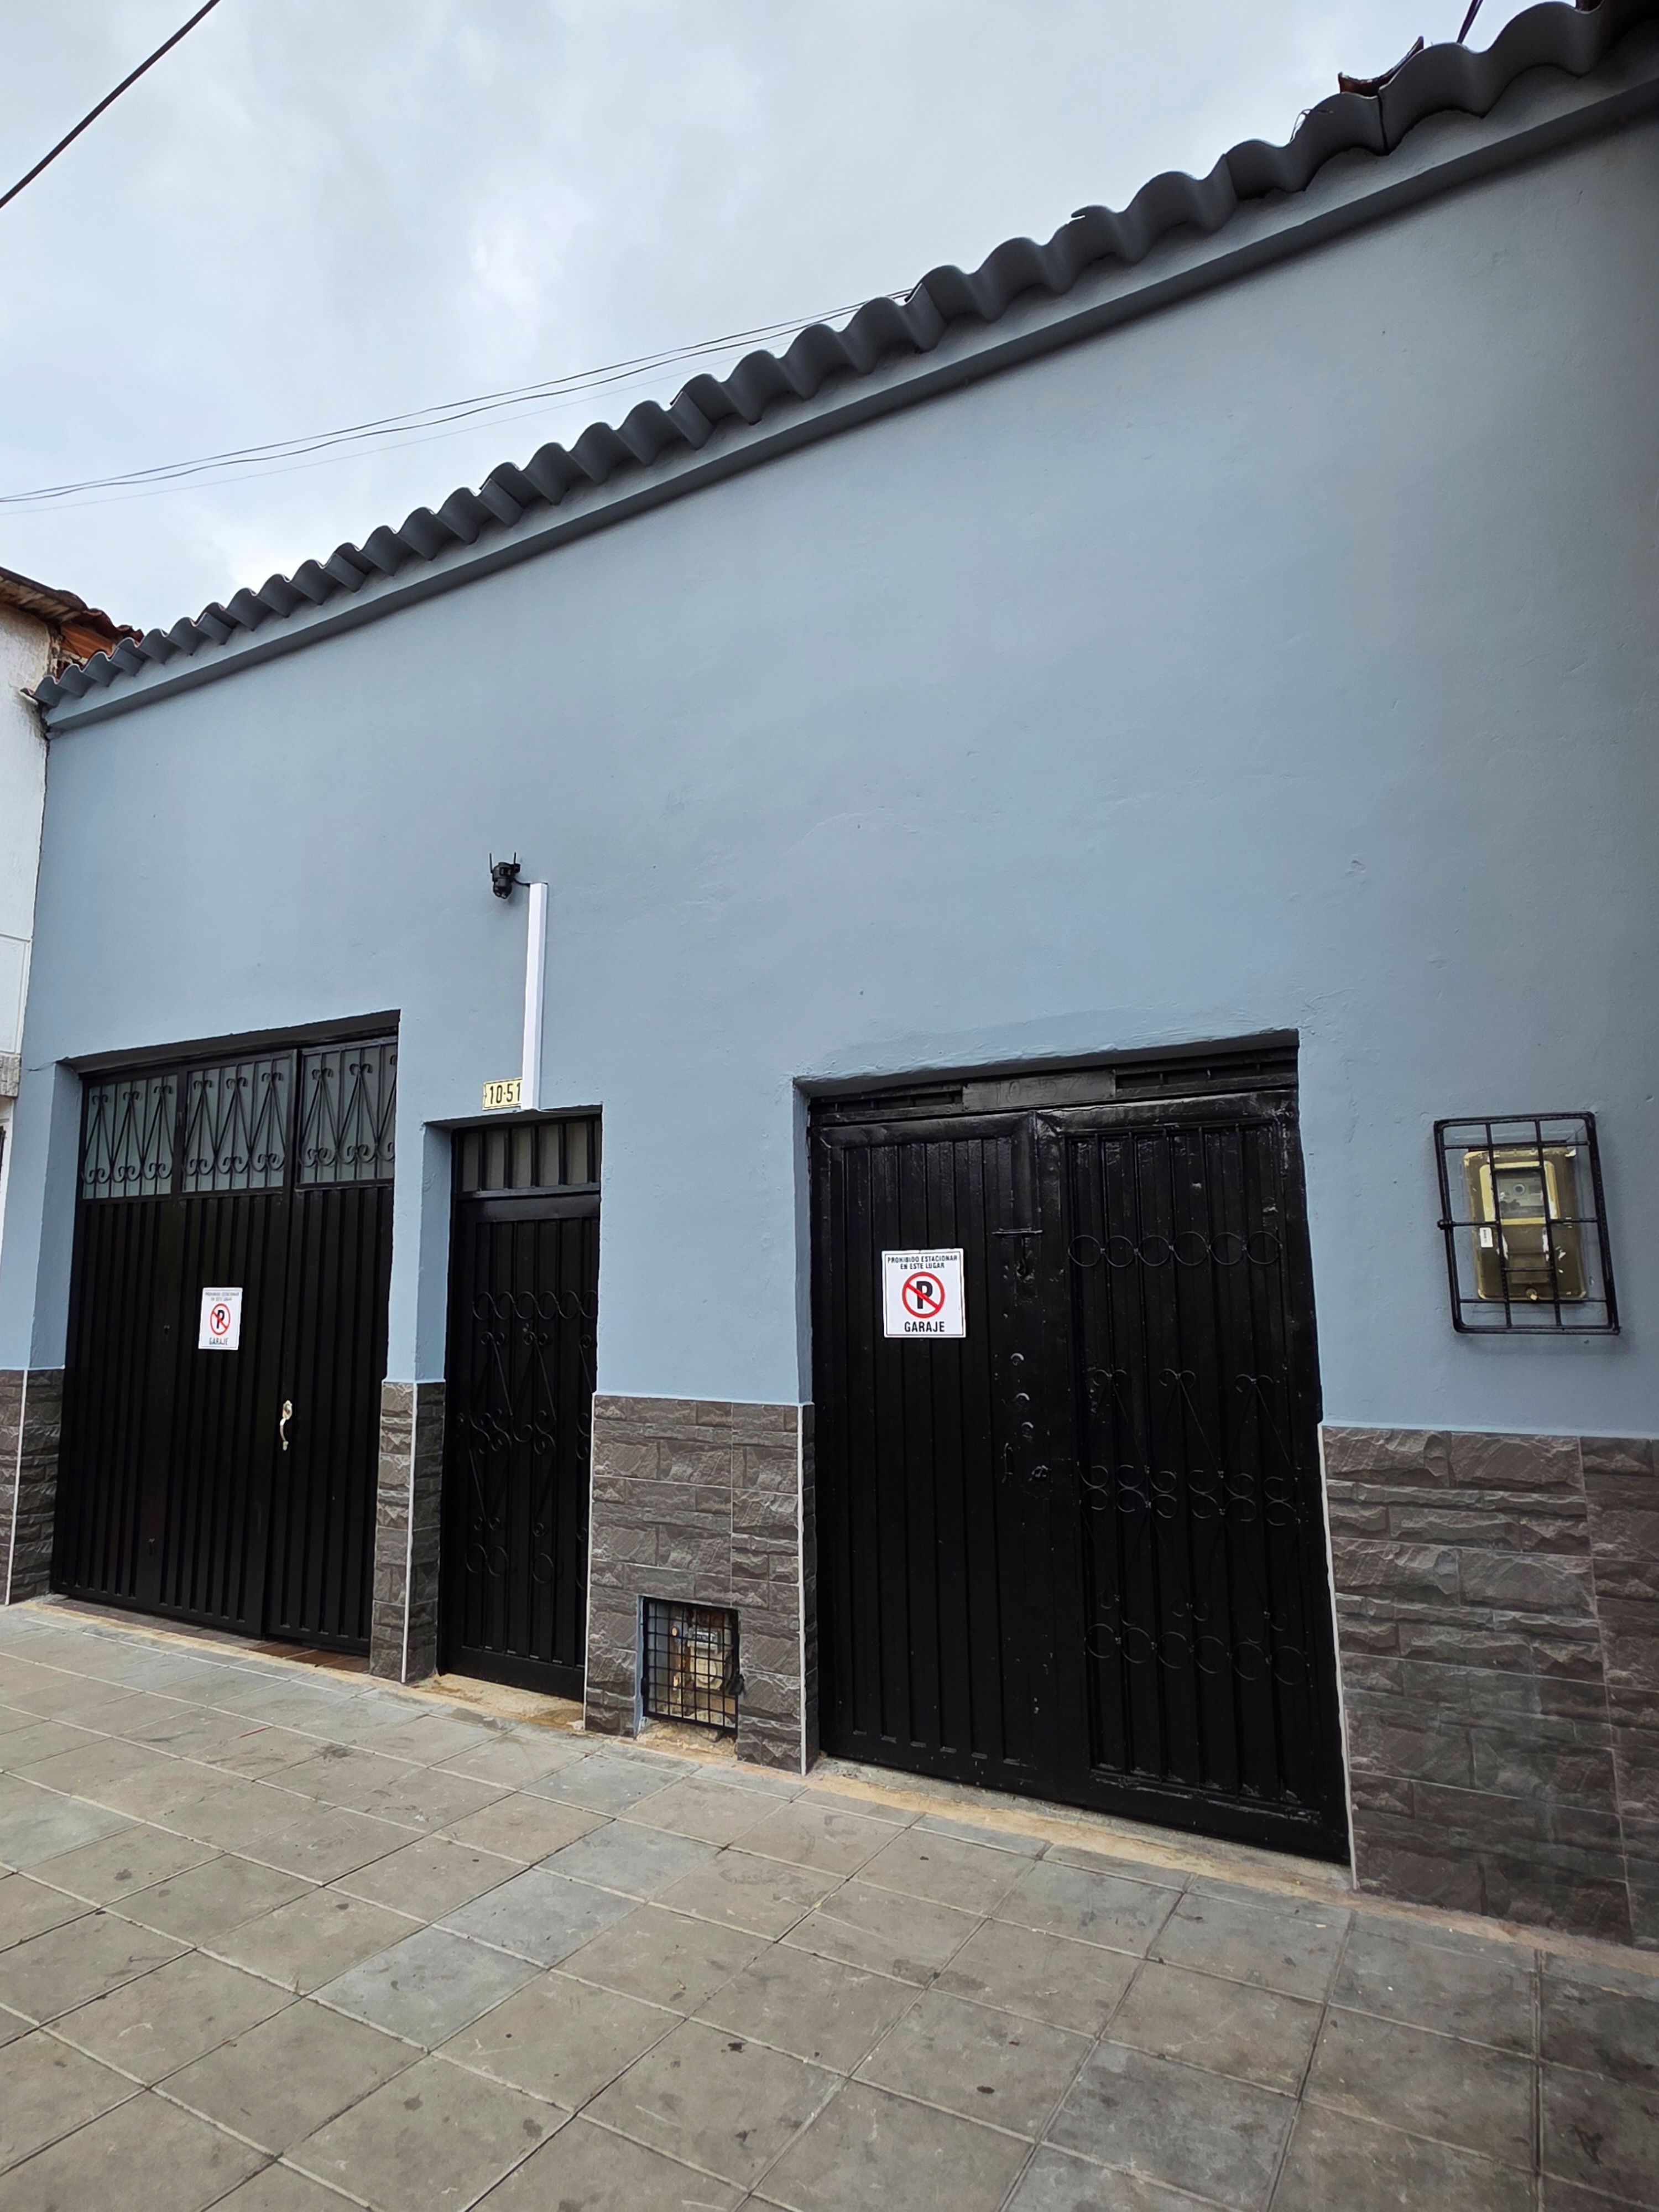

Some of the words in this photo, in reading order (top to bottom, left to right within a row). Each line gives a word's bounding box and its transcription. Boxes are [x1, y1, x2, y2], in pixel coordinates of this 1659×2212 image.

[916, 1281, 933, 1309] P
[904, 1321, 945, 1333] GARAJE
[209, 1337, 229, 1346] GARAJE
